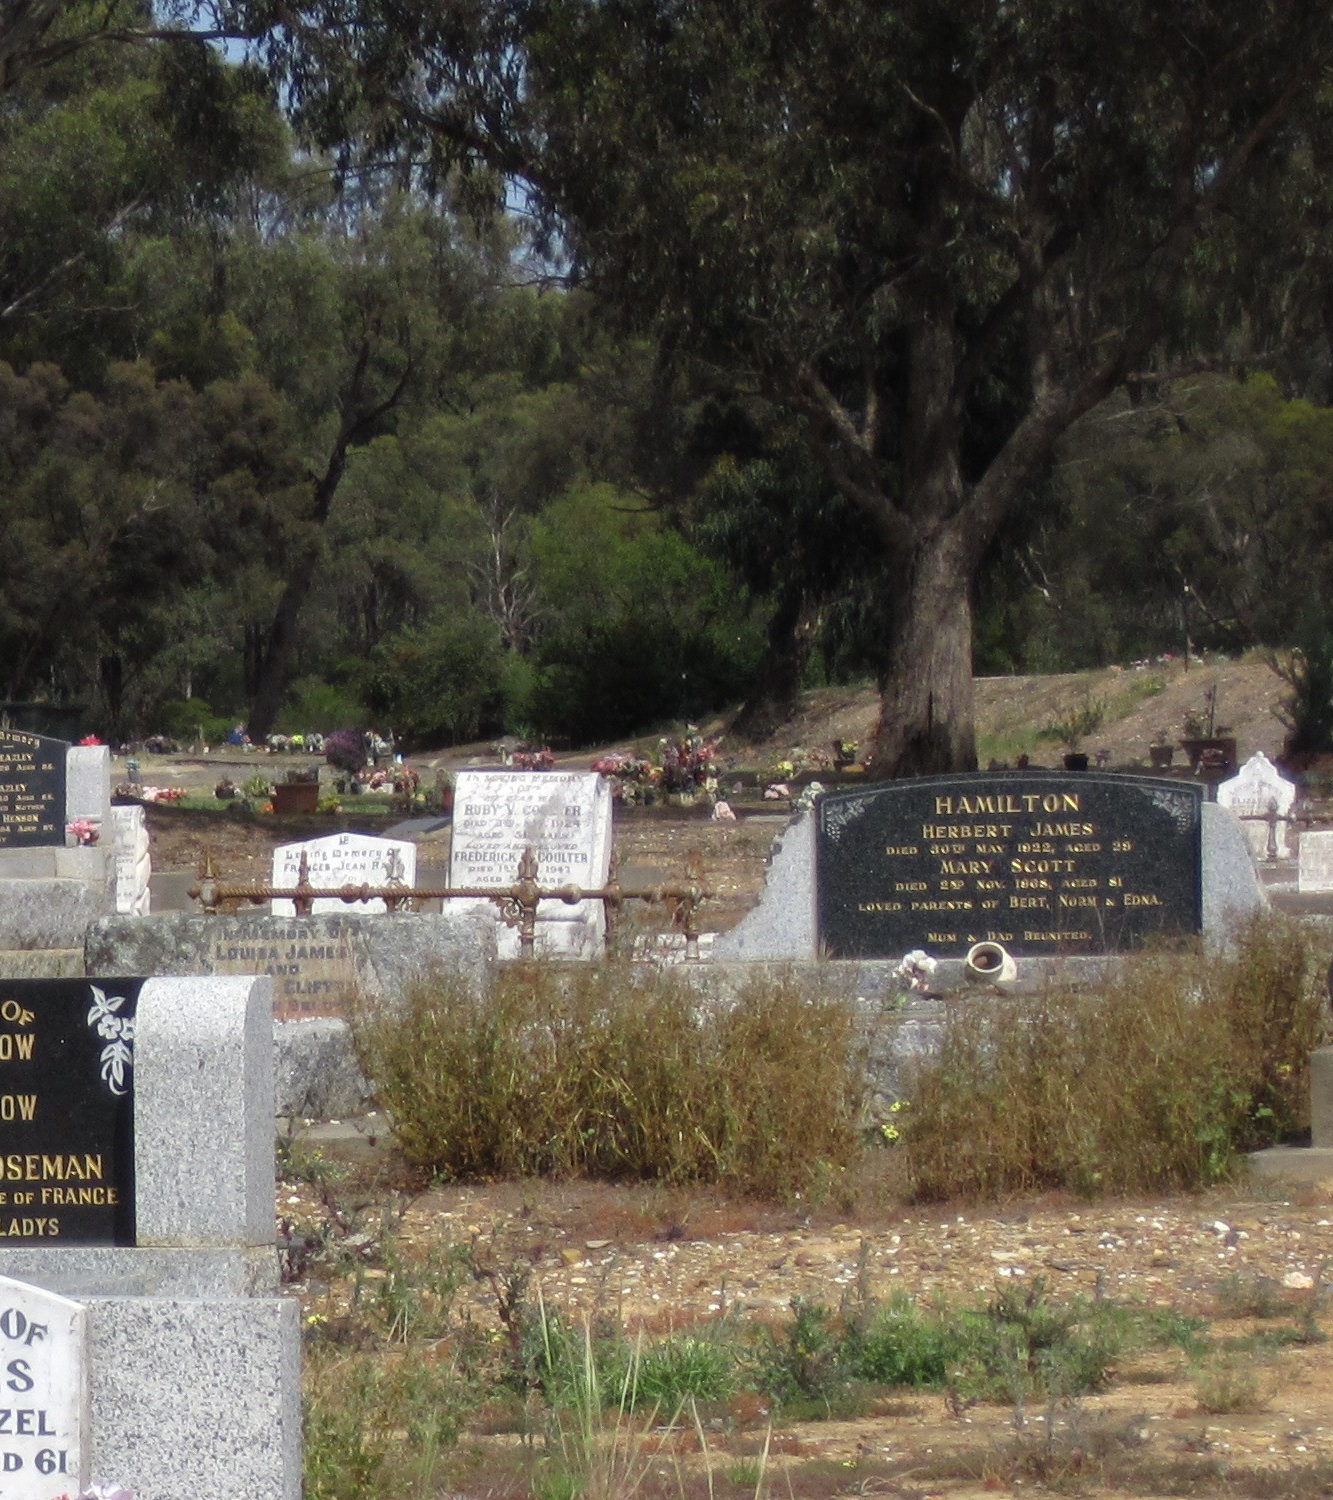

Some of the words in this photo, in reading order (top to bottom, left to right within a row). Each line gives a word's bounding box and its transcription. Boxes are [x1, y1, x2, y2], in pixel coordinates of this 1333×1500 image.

[935, 793, 1079, 815] HAMILTON
[922, 824, 1012, 839] HERBERT
[1030, 822, 1094, 837] JAMES
[885, 846, 918, 855] DIED
[976, 844, 1005, 854] MAY
[1065, 843, 1101, 852] AGED
[454, 852, 516, 862] FREDERICK
[538, 852, 588, 863] COULTER
[940, 860, 992, 874] MARY
[1010, 858, 1076, 873] SCOTT
[895, 882, 928, 891] DIED
[1061, 879, 1098, 888] AGED
[858, 902, 901, 911] LOVED
[911, 901, 973, 910] PARENTS
[982, 899, 999, 909] OF
[927, 932, 957, 942] MUM
[988, 931, 1014, 941] DAD
[1, 1000, 35, 1026] OF
[14, 1192, 34, 1205] OF
[0, 1308, 49, 1347] OF
[35, 1449, 68, 1474] 61
